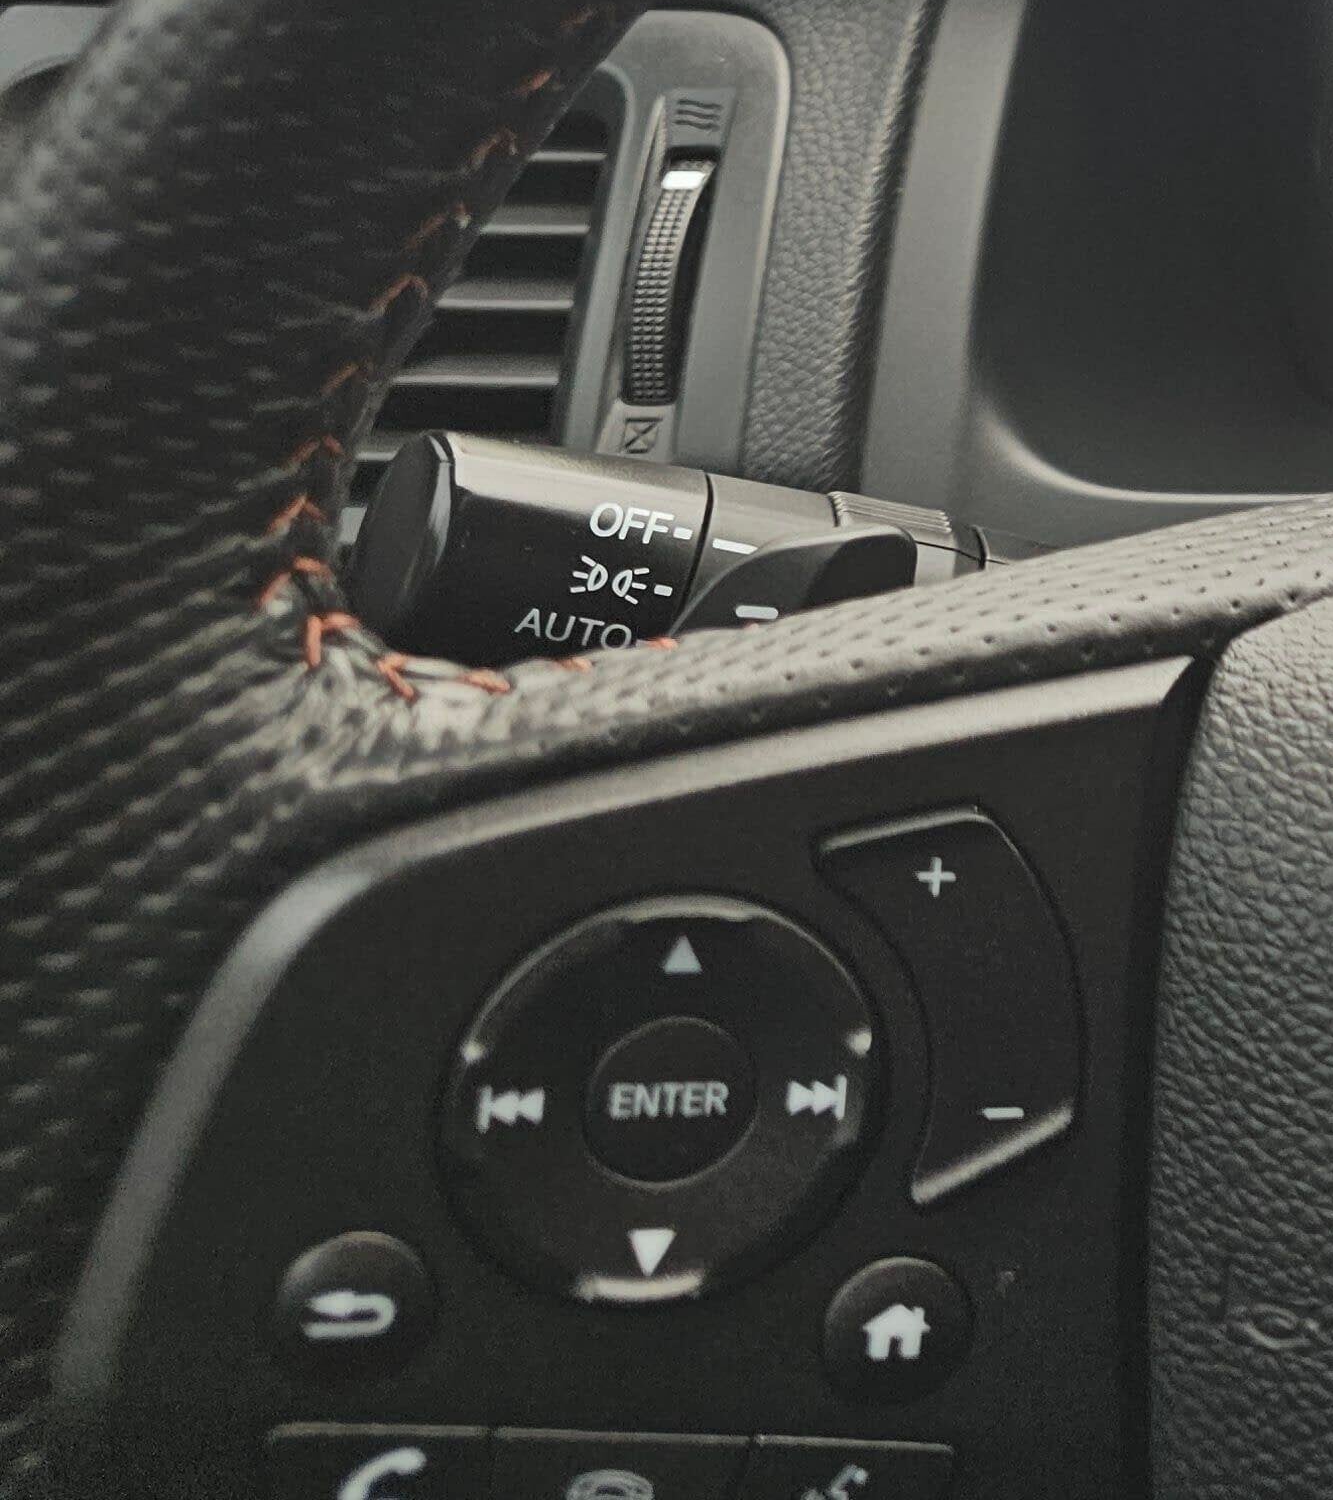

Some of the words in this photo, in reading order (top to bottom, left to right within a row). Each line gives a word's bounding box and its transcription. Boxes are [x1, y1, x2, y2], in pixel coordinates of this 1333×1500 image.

[590, 502, 675, 544] OFF
[514, 608, 632, 650] AUTO
[608, 1081, 729, 1119] ENTER
